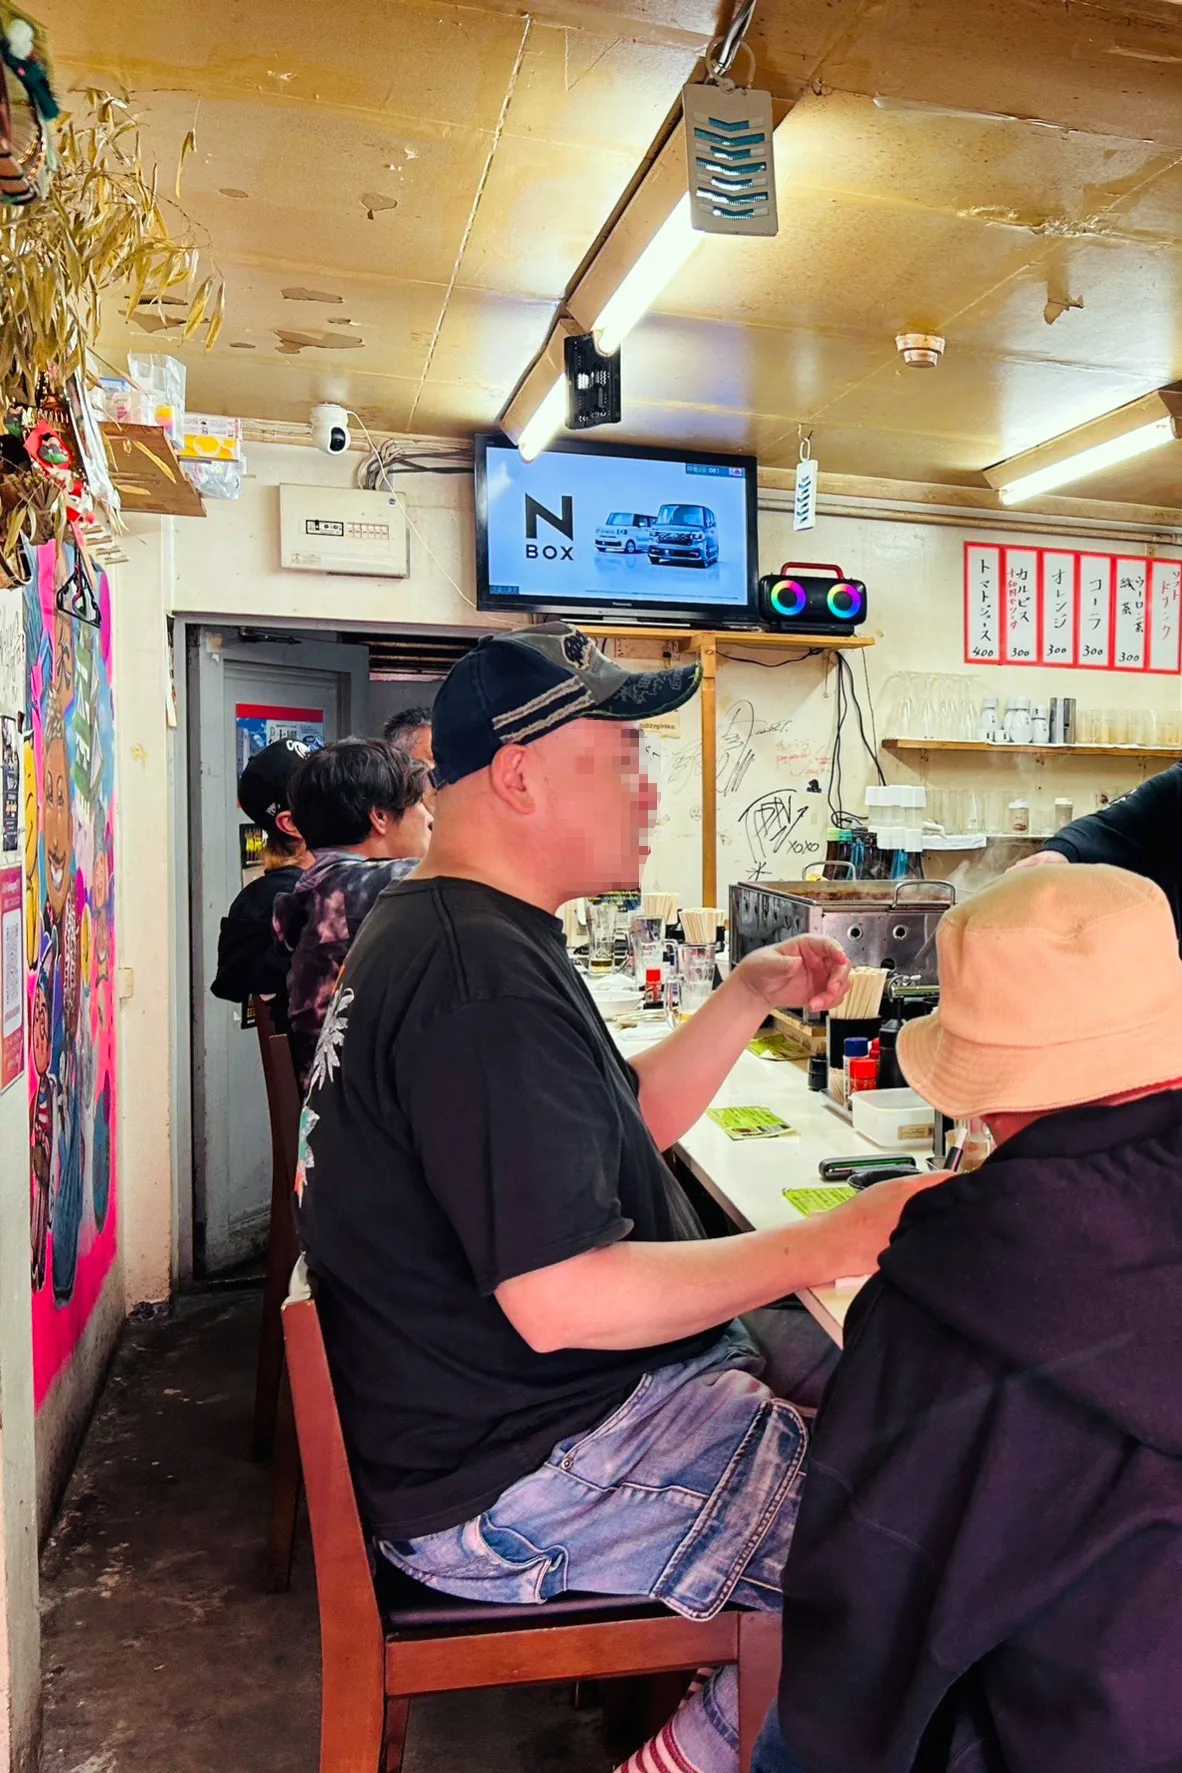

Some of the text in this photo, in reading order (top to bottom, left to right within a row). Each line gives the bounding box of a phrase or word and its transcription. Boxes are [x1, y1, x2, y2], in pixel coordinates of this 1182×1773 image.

[525, 493, 574, 542] N
[525, 545, 574, 561] BOX
[980, 559, 992, 642] トマトジュース
[1017, 568, 1031, 622] カルピス
[1051, 568, 1068, 629] オレンジ
[1089, 579, 1102, 631] コーラ
[1135, 576, 1145, 633] ウーロン茶
[972, 646, 994, 657] 400
[1011, 647, 1030, 657] 300
[1047, 644, 1067, 656] 300
[1082, 645, 1104, 657] 300
[1119, 652, 1140, 662] 300
